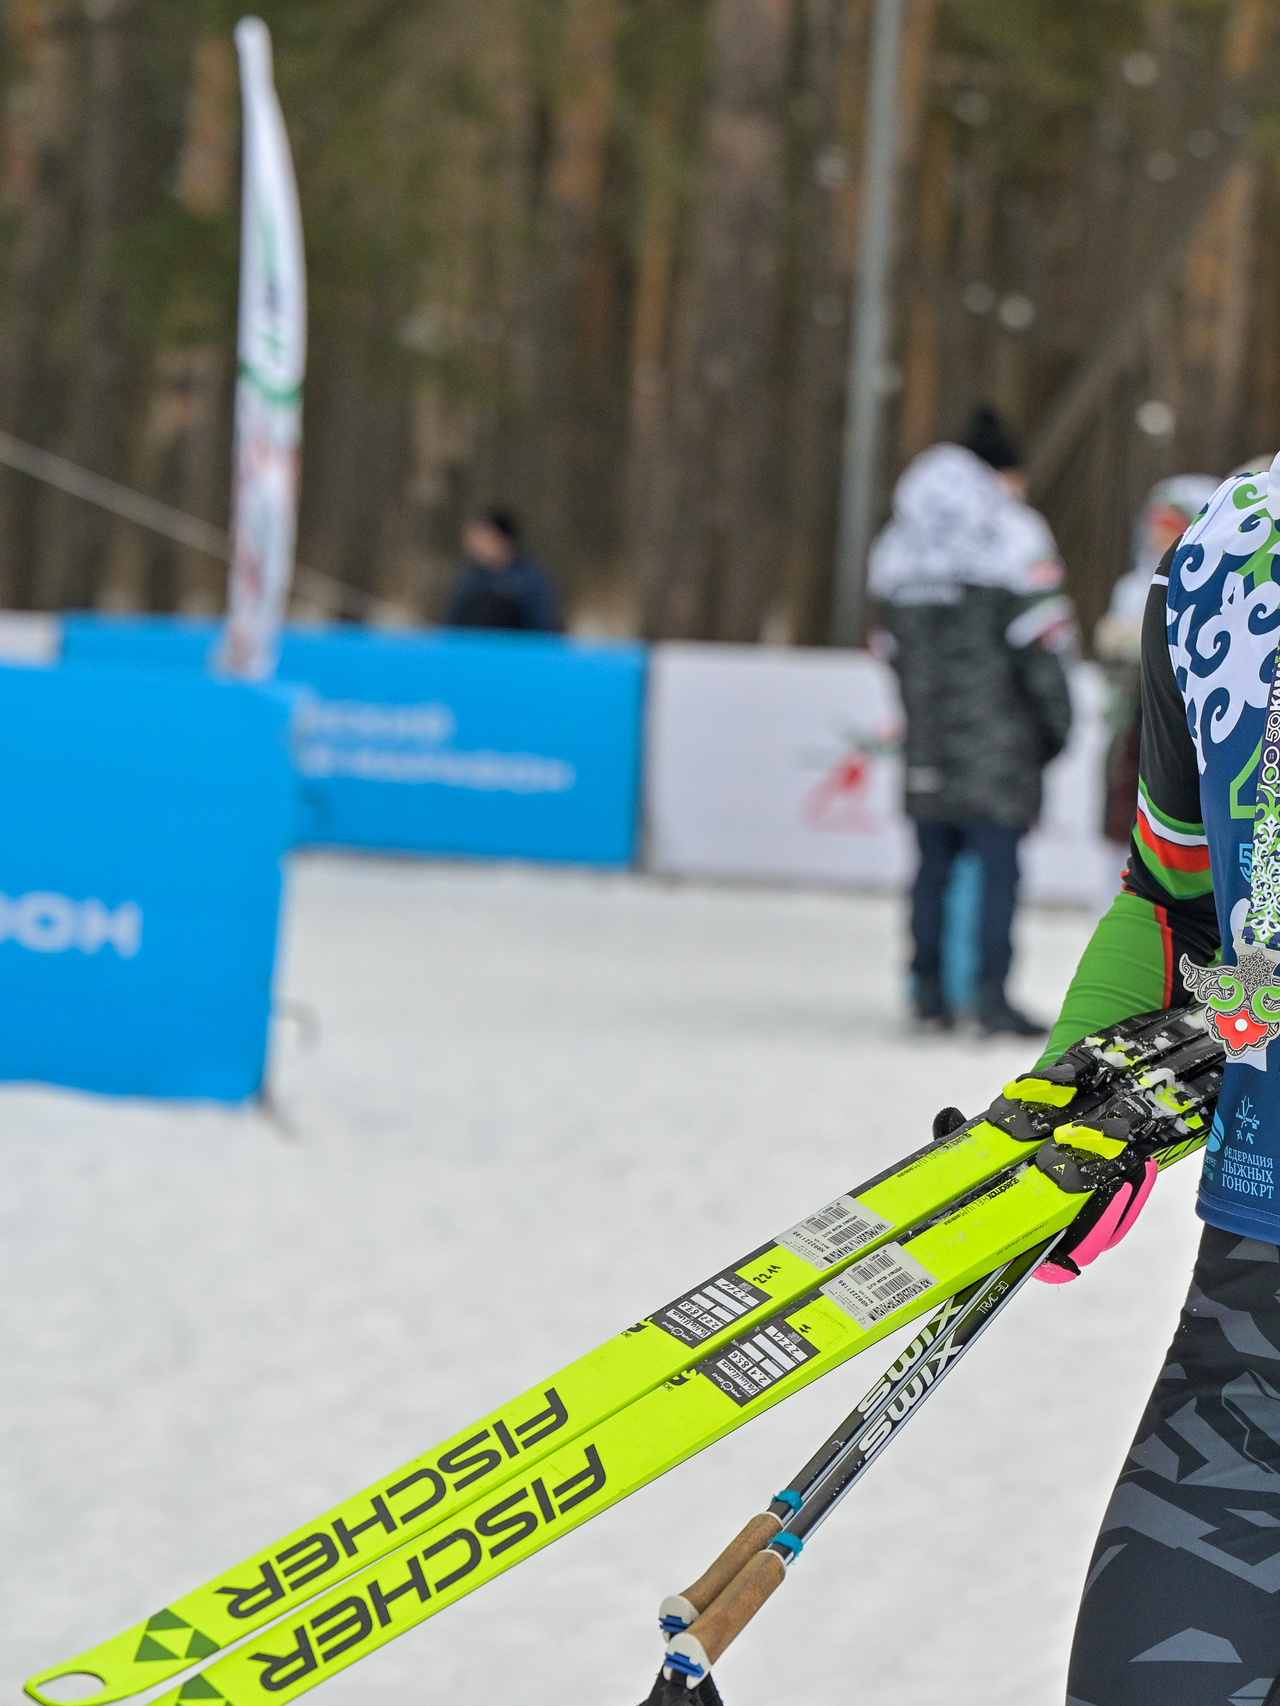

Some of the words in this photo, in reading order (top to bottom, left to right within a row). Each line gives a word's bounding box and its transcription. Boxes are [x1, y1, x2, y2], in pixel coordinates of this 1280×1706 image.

[1224, 1145, 1274, 1169] ФЕДЕРАЦИЯ
[1222, 1159, 1274, 1184] ЛЫЖНЫХ
[771, 1331, 800, 1355] 2211
[214, 1387, 569, 1619] FISCHER
[248, 1443, 607, 1692] FISCHER
